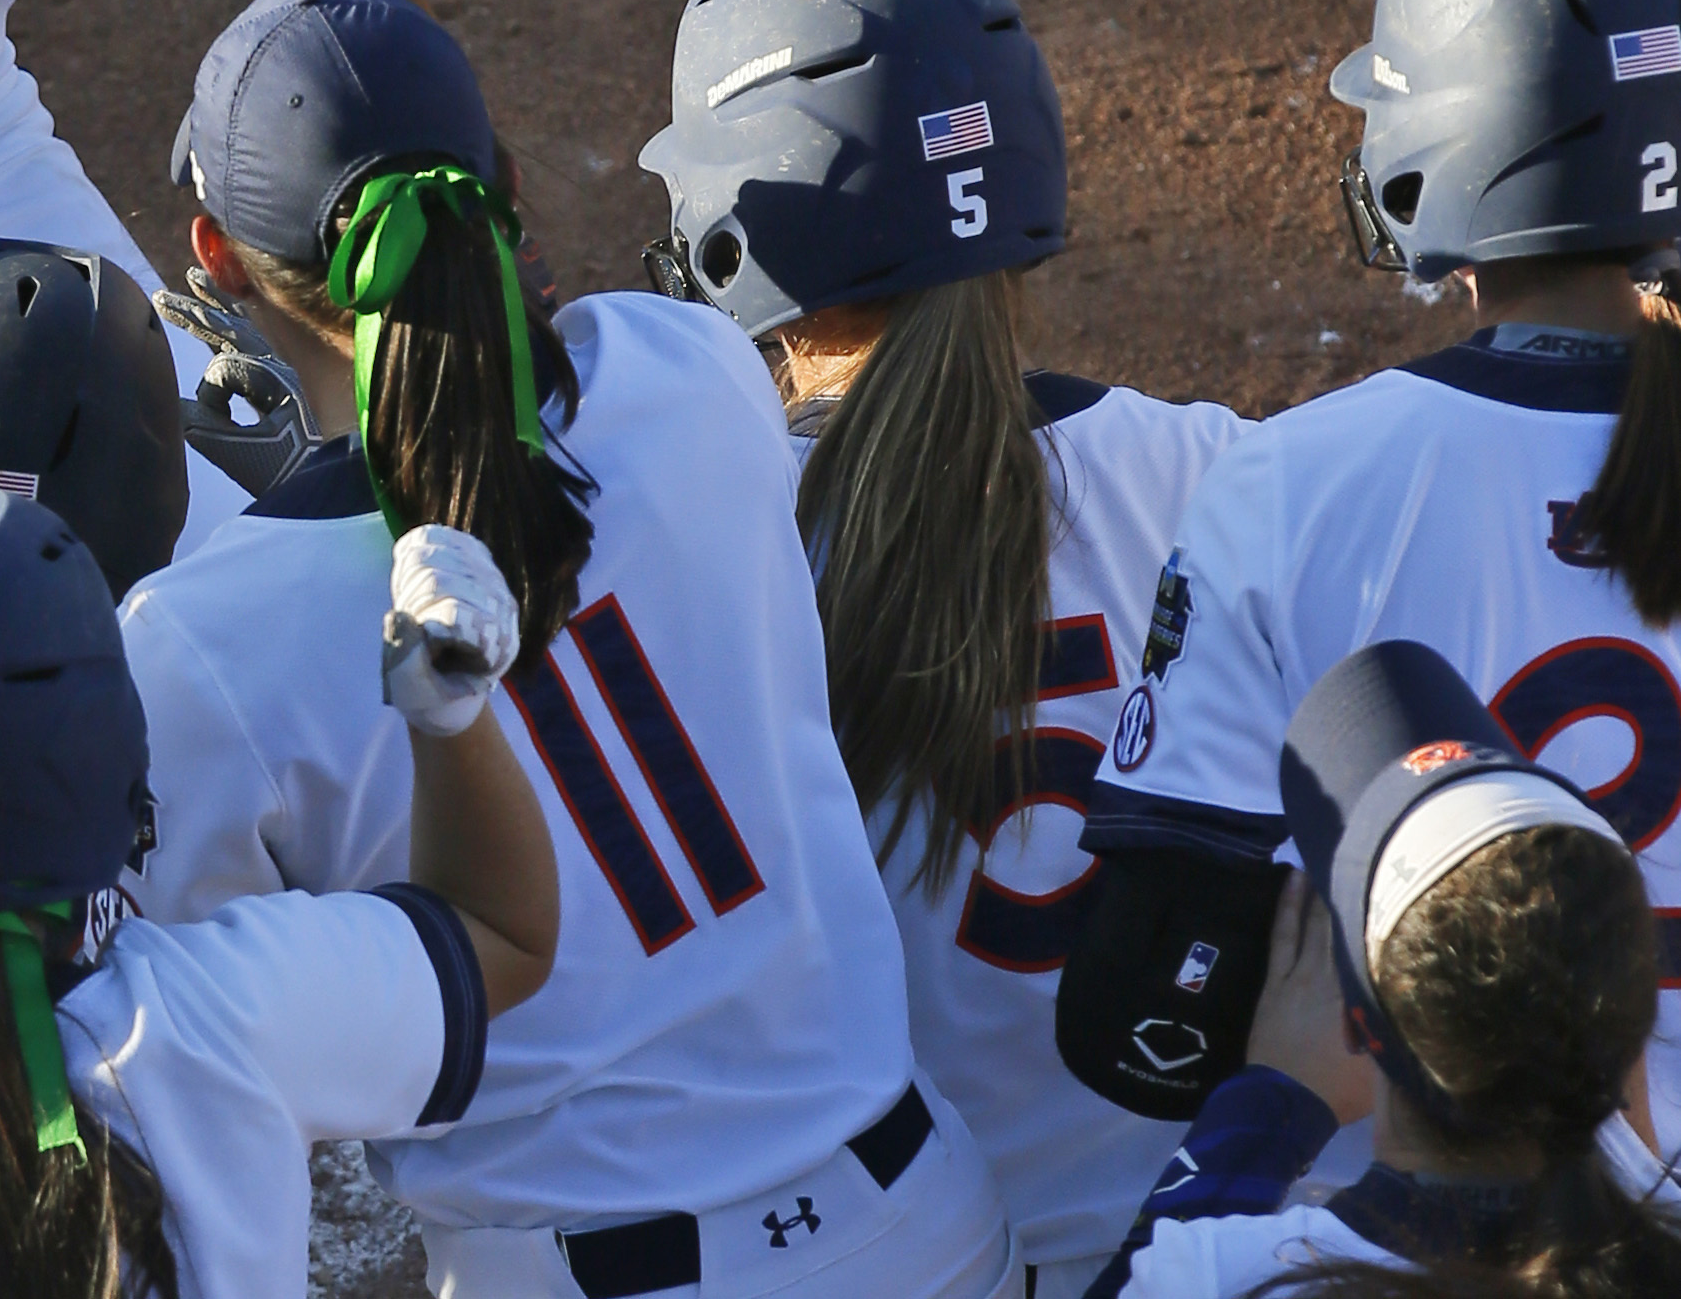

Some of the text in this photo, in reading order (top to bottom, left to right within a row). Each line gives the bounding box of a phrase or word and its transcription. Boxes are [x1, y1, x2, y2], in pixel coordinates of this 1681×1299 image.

[946, 166, 988, 239] 5
[1641, 141, 1679, 213] 2
[499, 592, 767, 958] 11
[1118, 1061, 1199, 1088] EVOSHIELD
